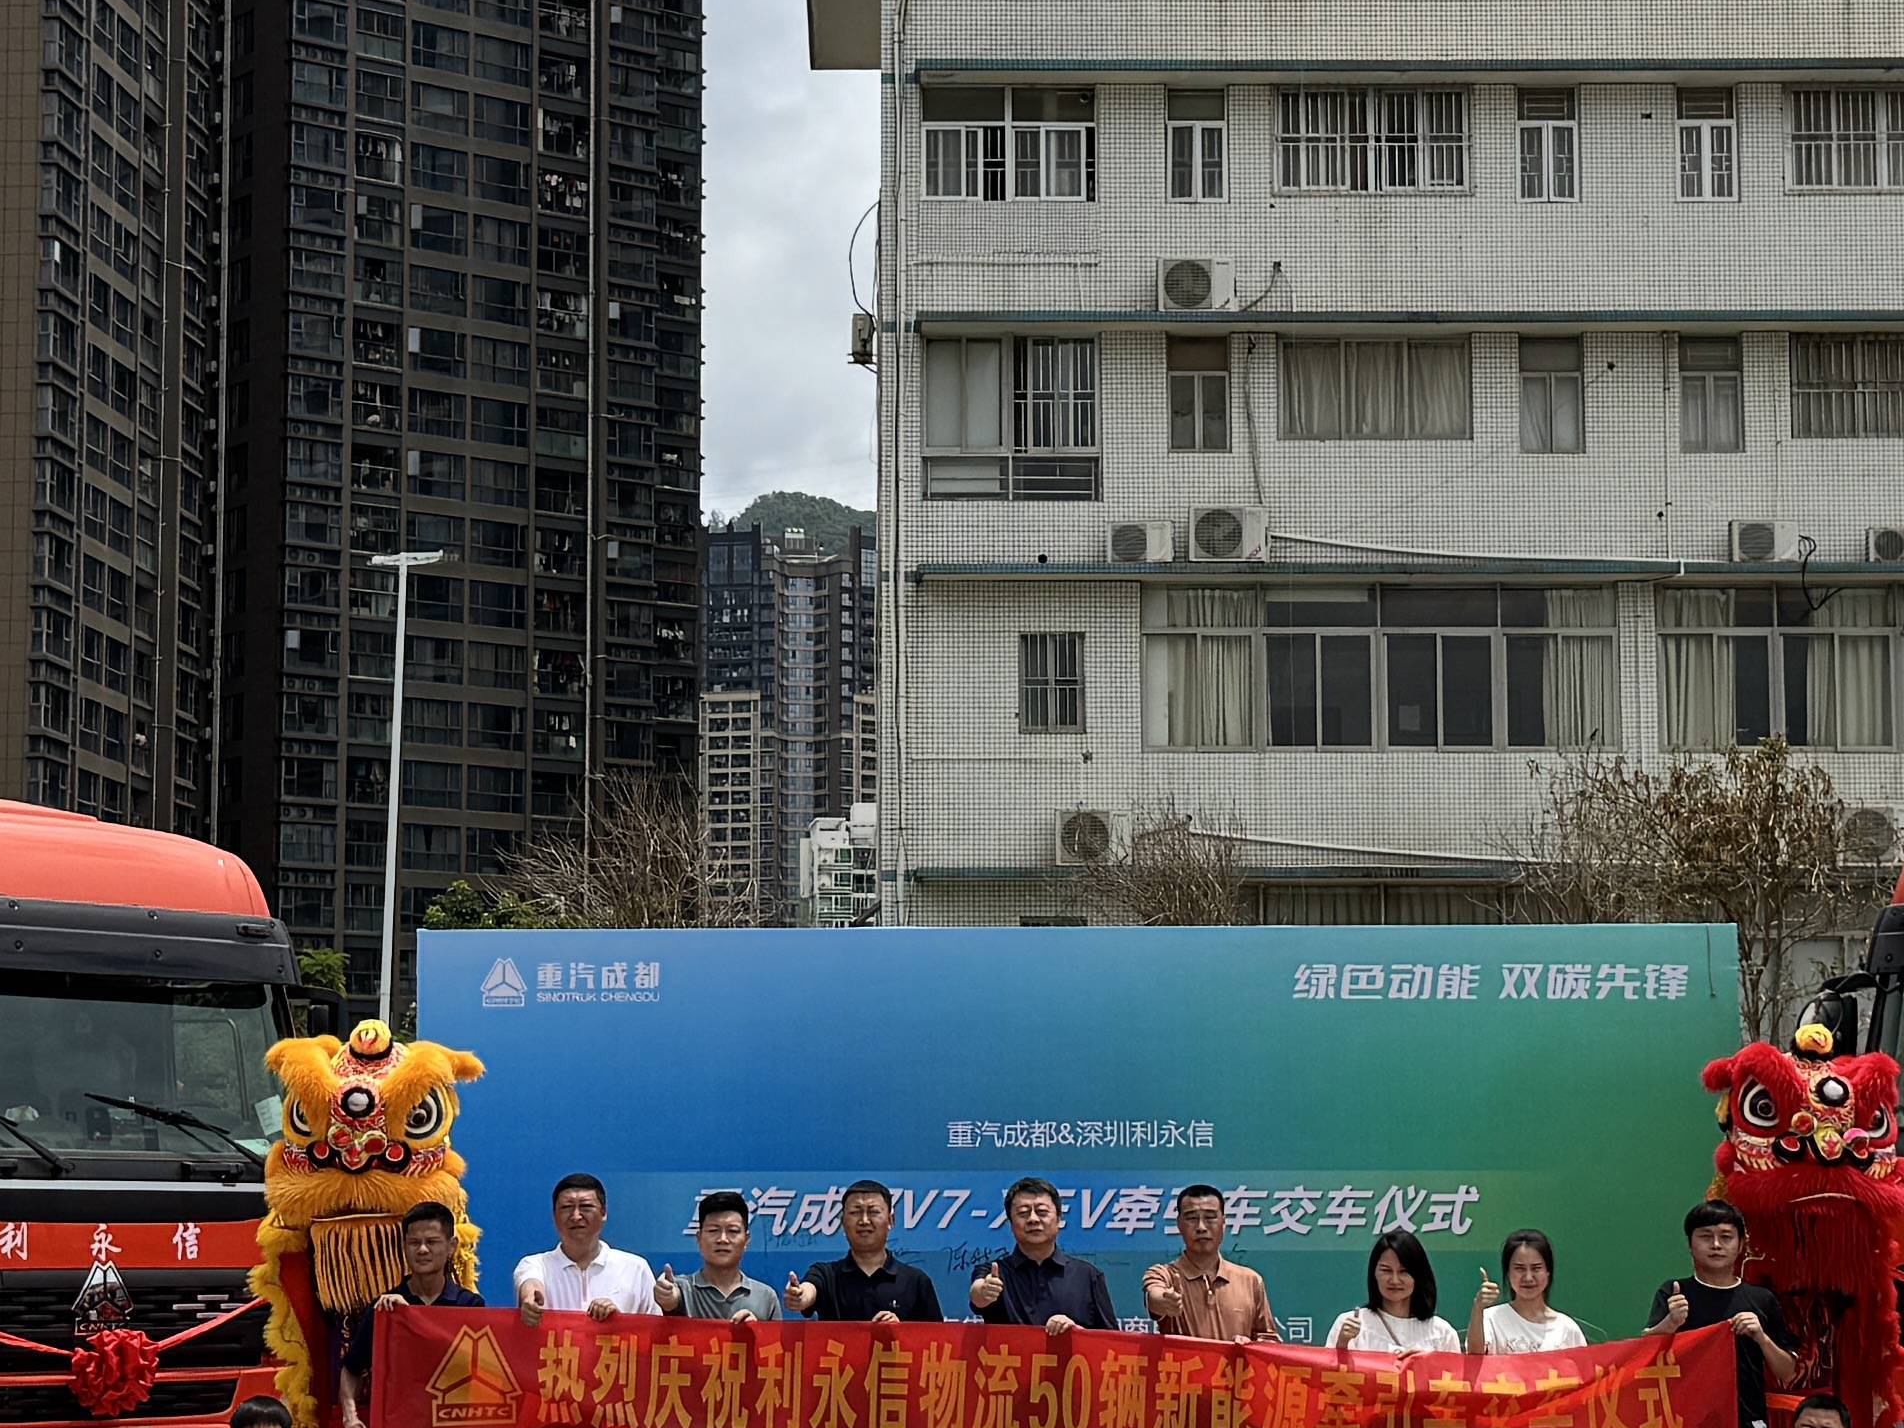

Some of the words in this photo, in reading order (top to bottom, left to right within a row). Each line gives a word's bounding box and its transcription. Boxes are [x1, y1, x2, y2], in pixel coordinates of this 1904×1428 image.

[536, 961, 660, 990] 重汽成都
[1293, 963, 1482, 1000] 绿色动能
[1498, 963, 1689, 1000] 双碳先锋
[536, 992, 596, 1002] SINOTRUK
[601, 991, 660, 1002] CHENGDU
[946, 1120, 1214, 1149] 重汽成都&深圳利永信
[438, 1405, 511, 1419] CNHTC
